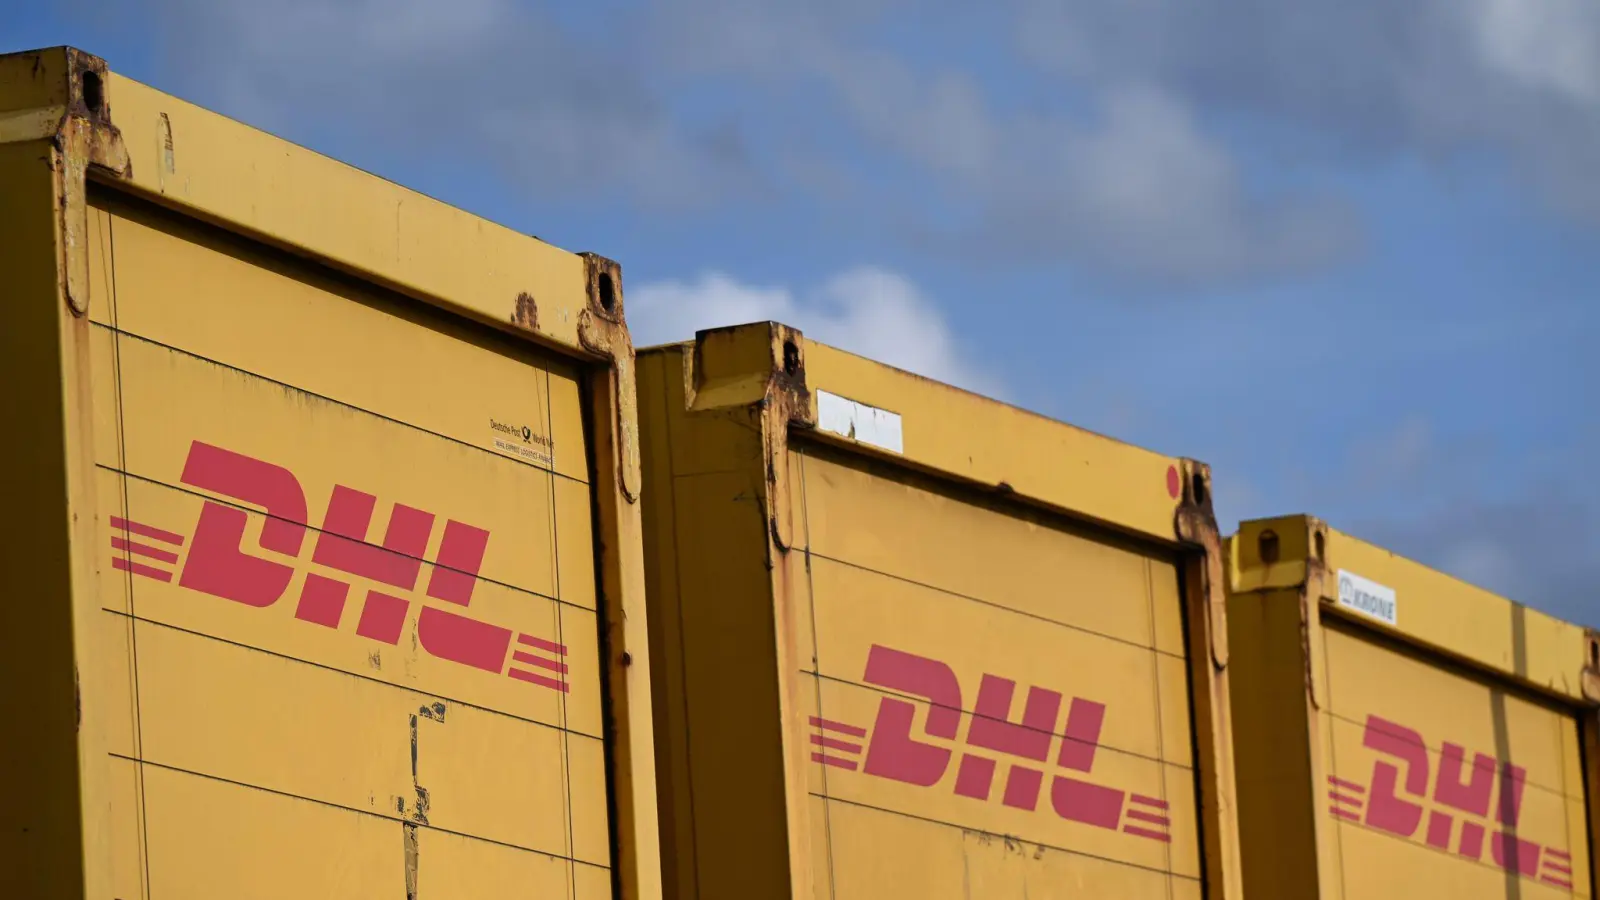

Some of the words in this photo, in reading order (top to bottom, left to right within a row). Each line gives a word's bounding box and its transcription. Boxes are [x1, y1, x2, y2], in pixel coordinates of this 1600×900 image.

[490, 419, 511, 435] Deutsche
[511, 426, 521, 438] Post
[180, 440, 512, 674] DHL
[1354, 588, 1394, 620] KRONE
[865, 644, 1124, 830] DHL
[1364, 714, 1541, 878] DHL
